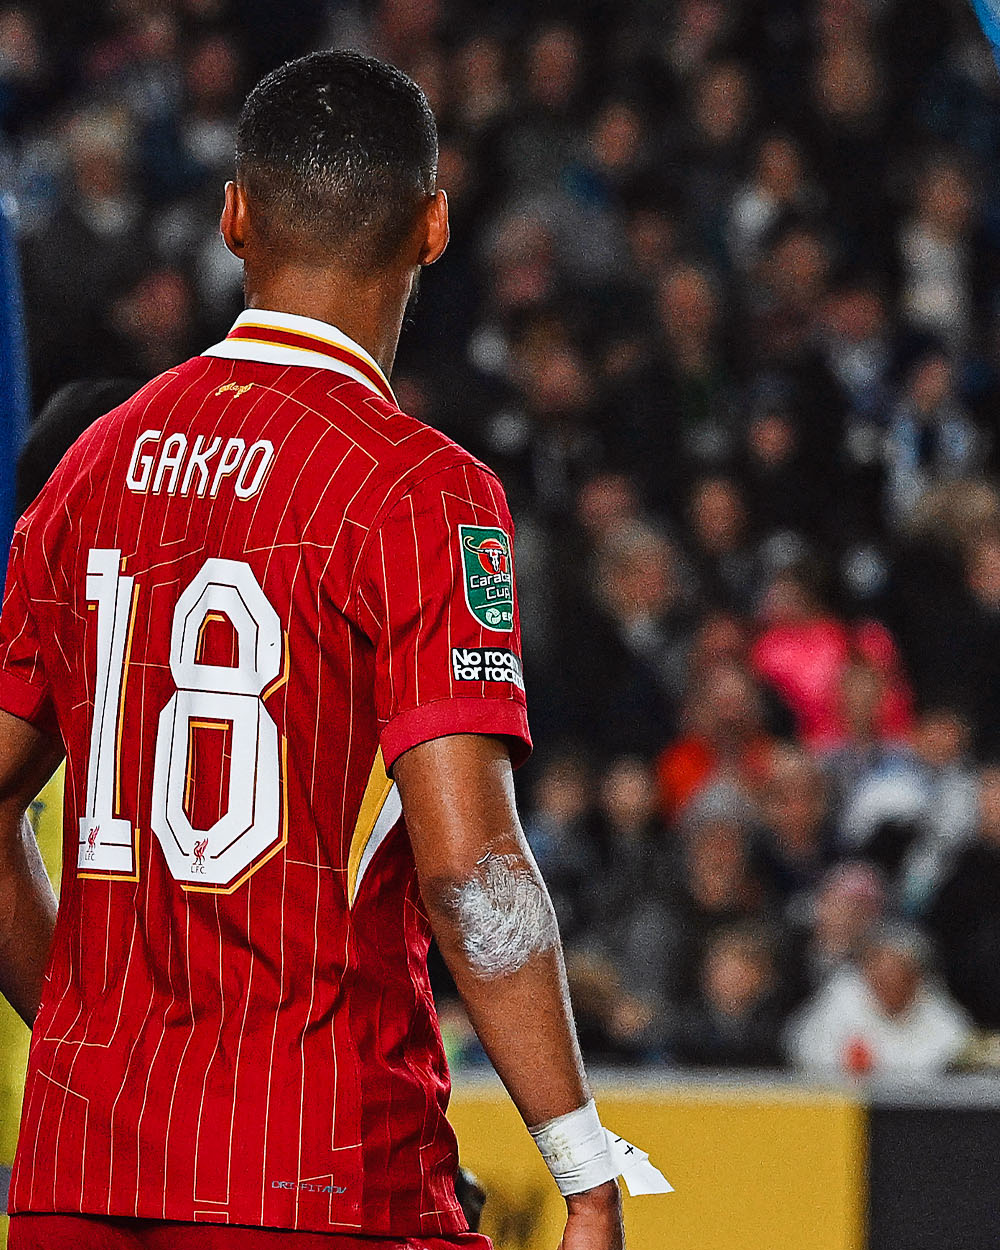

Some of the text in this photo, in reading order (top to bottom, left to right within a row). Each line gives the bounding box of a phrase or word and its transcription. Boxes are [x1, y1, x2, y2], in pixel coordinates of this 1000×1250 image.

[126, 429, 274, 501] GAKPO
[470, 571, 511, 588] Caraba
[486, 586, 511, 600] Cup
[502, 611, 513, 622] EF
[452, 648, 482, 666] No
[77, 548, 288, 893] 18
